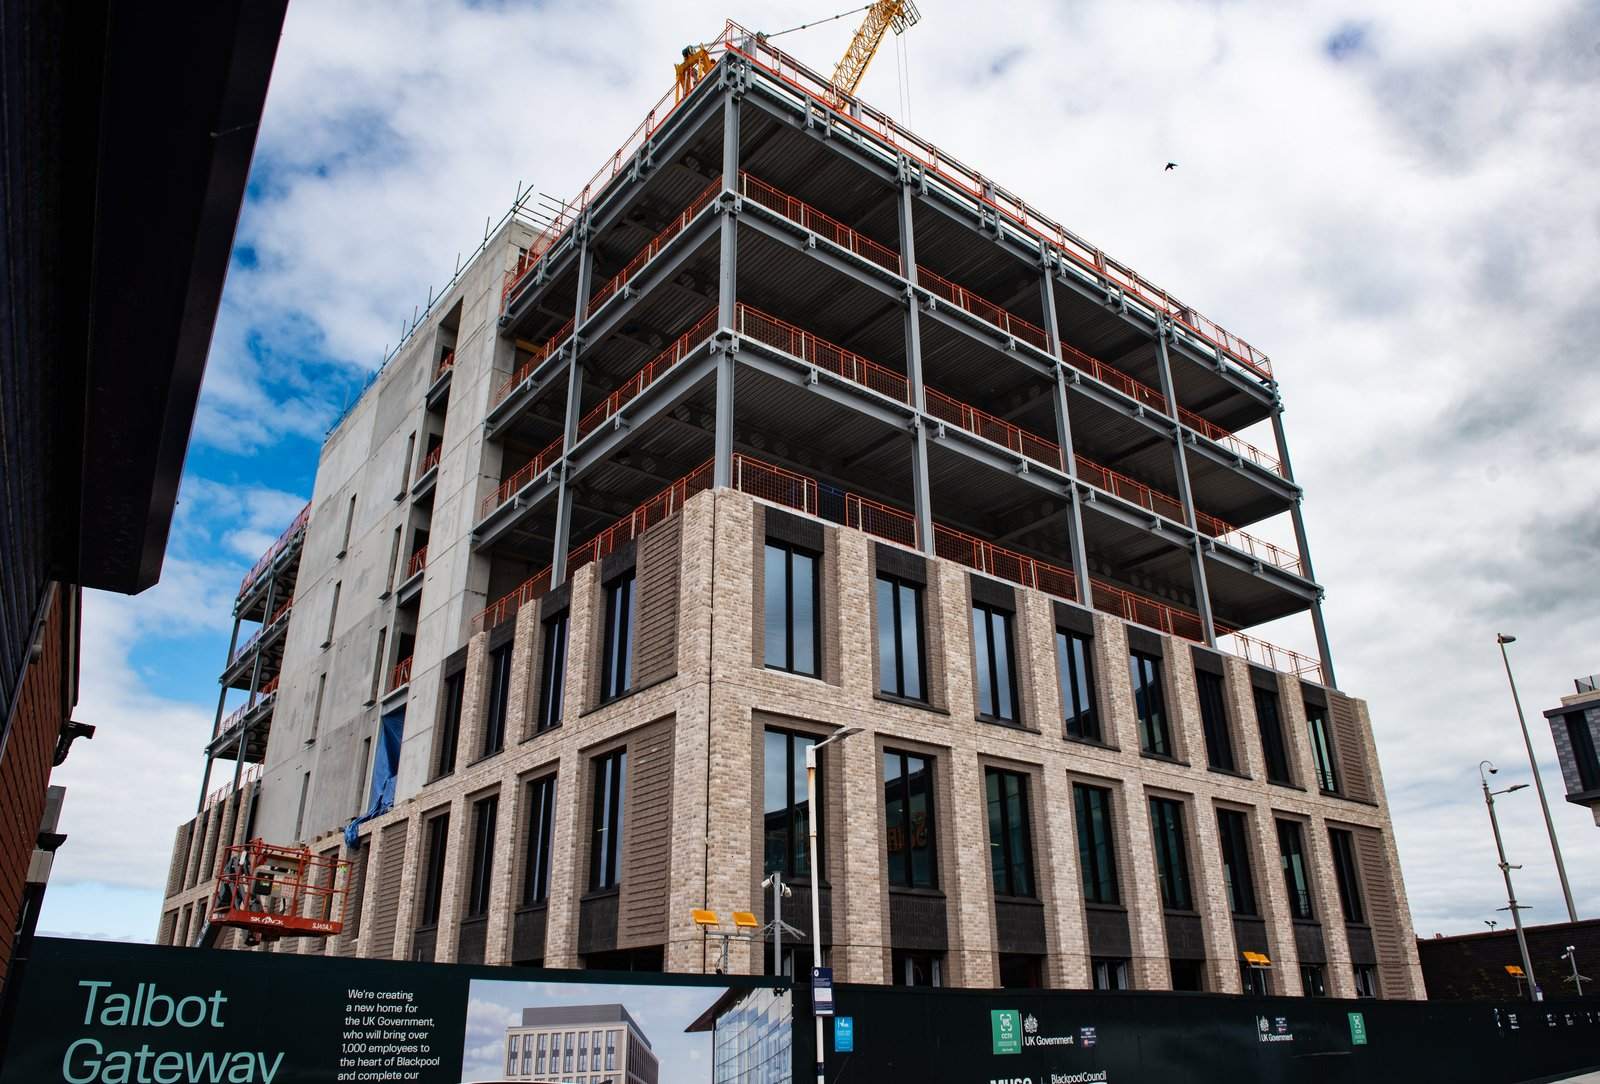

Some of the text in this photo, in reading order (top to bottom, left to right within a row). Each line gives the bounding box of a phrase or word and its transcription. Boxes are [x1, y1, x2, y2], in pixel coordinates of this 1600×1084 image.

[348, 989, 414, 1002] We're creating
[78, 980, 228, 1028] Talbot
[377, 1003, 402, 1013] home
[405, 1004, 418, 1013] for
[345, 1017, 435, 1026] the UK Government,
[343, 1031, 363, 1039] who
[366, 1030, 381, 1039] will
[383, 1031, 406, 1041] bring
[1025, 1036, 1036, 1046] UK
[1037, 1035, 1073, 1046] Government
[1261, 1034, 1269, 1042] UK
[342, 1043, 430, 1055] 1,000 employees to
[61, 1038, 285, 1084] Gateway
[340, 1057, 440, 1068] the heart of Blackpool
[337, 1071, 355, 1080] and
[358, 1071, 402, 1082] complete
